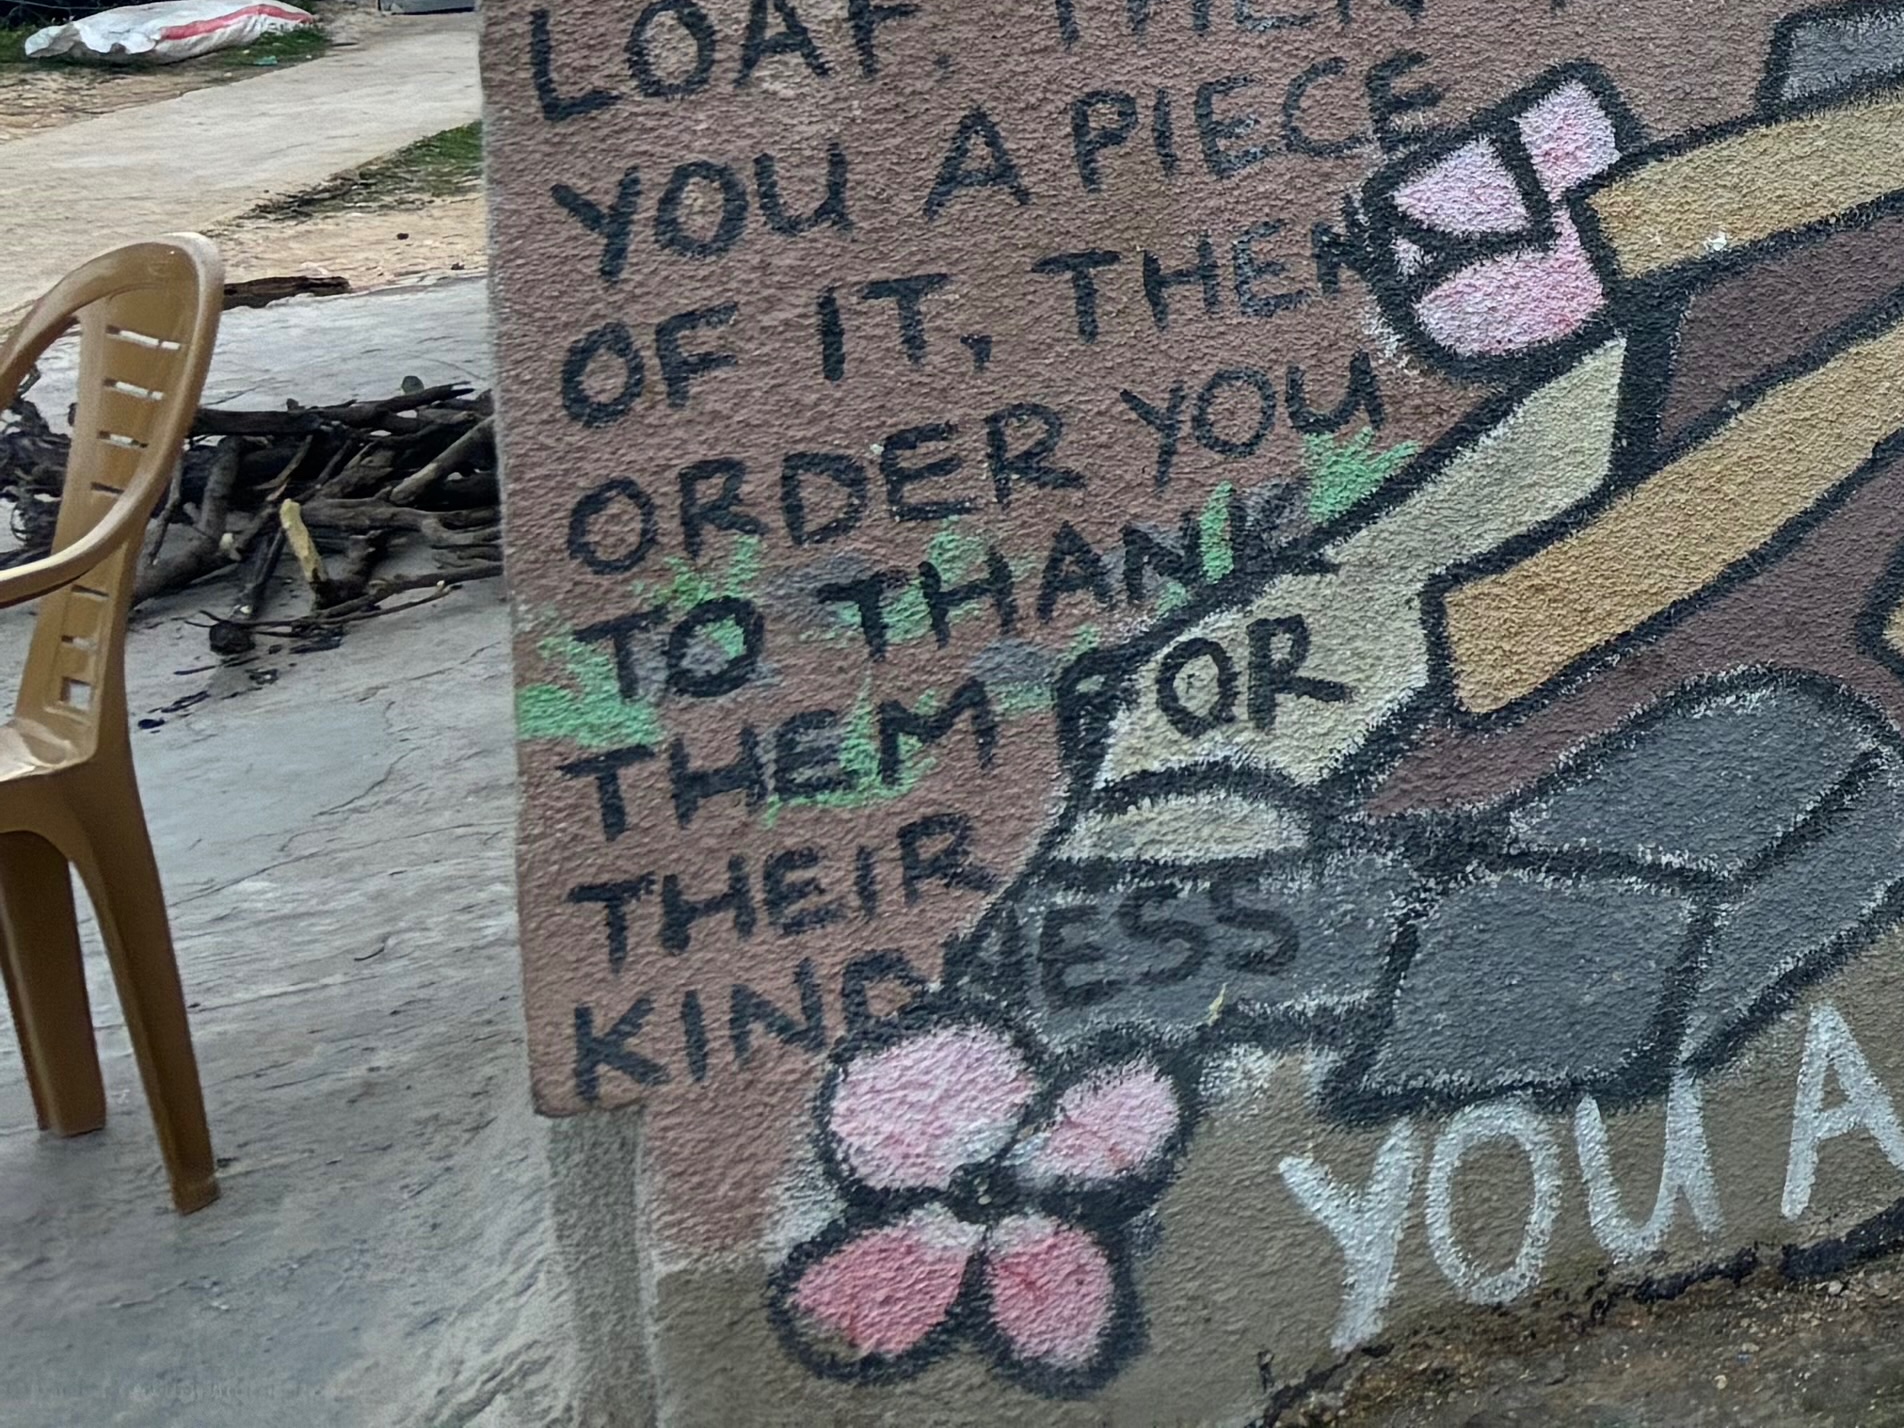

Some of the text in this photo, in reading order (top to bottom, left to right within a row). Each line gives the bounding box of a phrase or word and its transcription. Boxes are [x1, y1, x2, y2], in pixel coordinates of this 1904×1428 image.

[550, 51, 1453, 284] YOU A PIECE
[560, 299, 738, 429] OF
[818, 272, 992, 381] IT,
[567, 349, 1385, 574] ORDER YOU
[570, 596, 765, 699] TO
[560, 676, 998, 841] THEM
[566, 811, 1002, 974] THEIR
[1277, 1066, 1725, 1347] YOU
